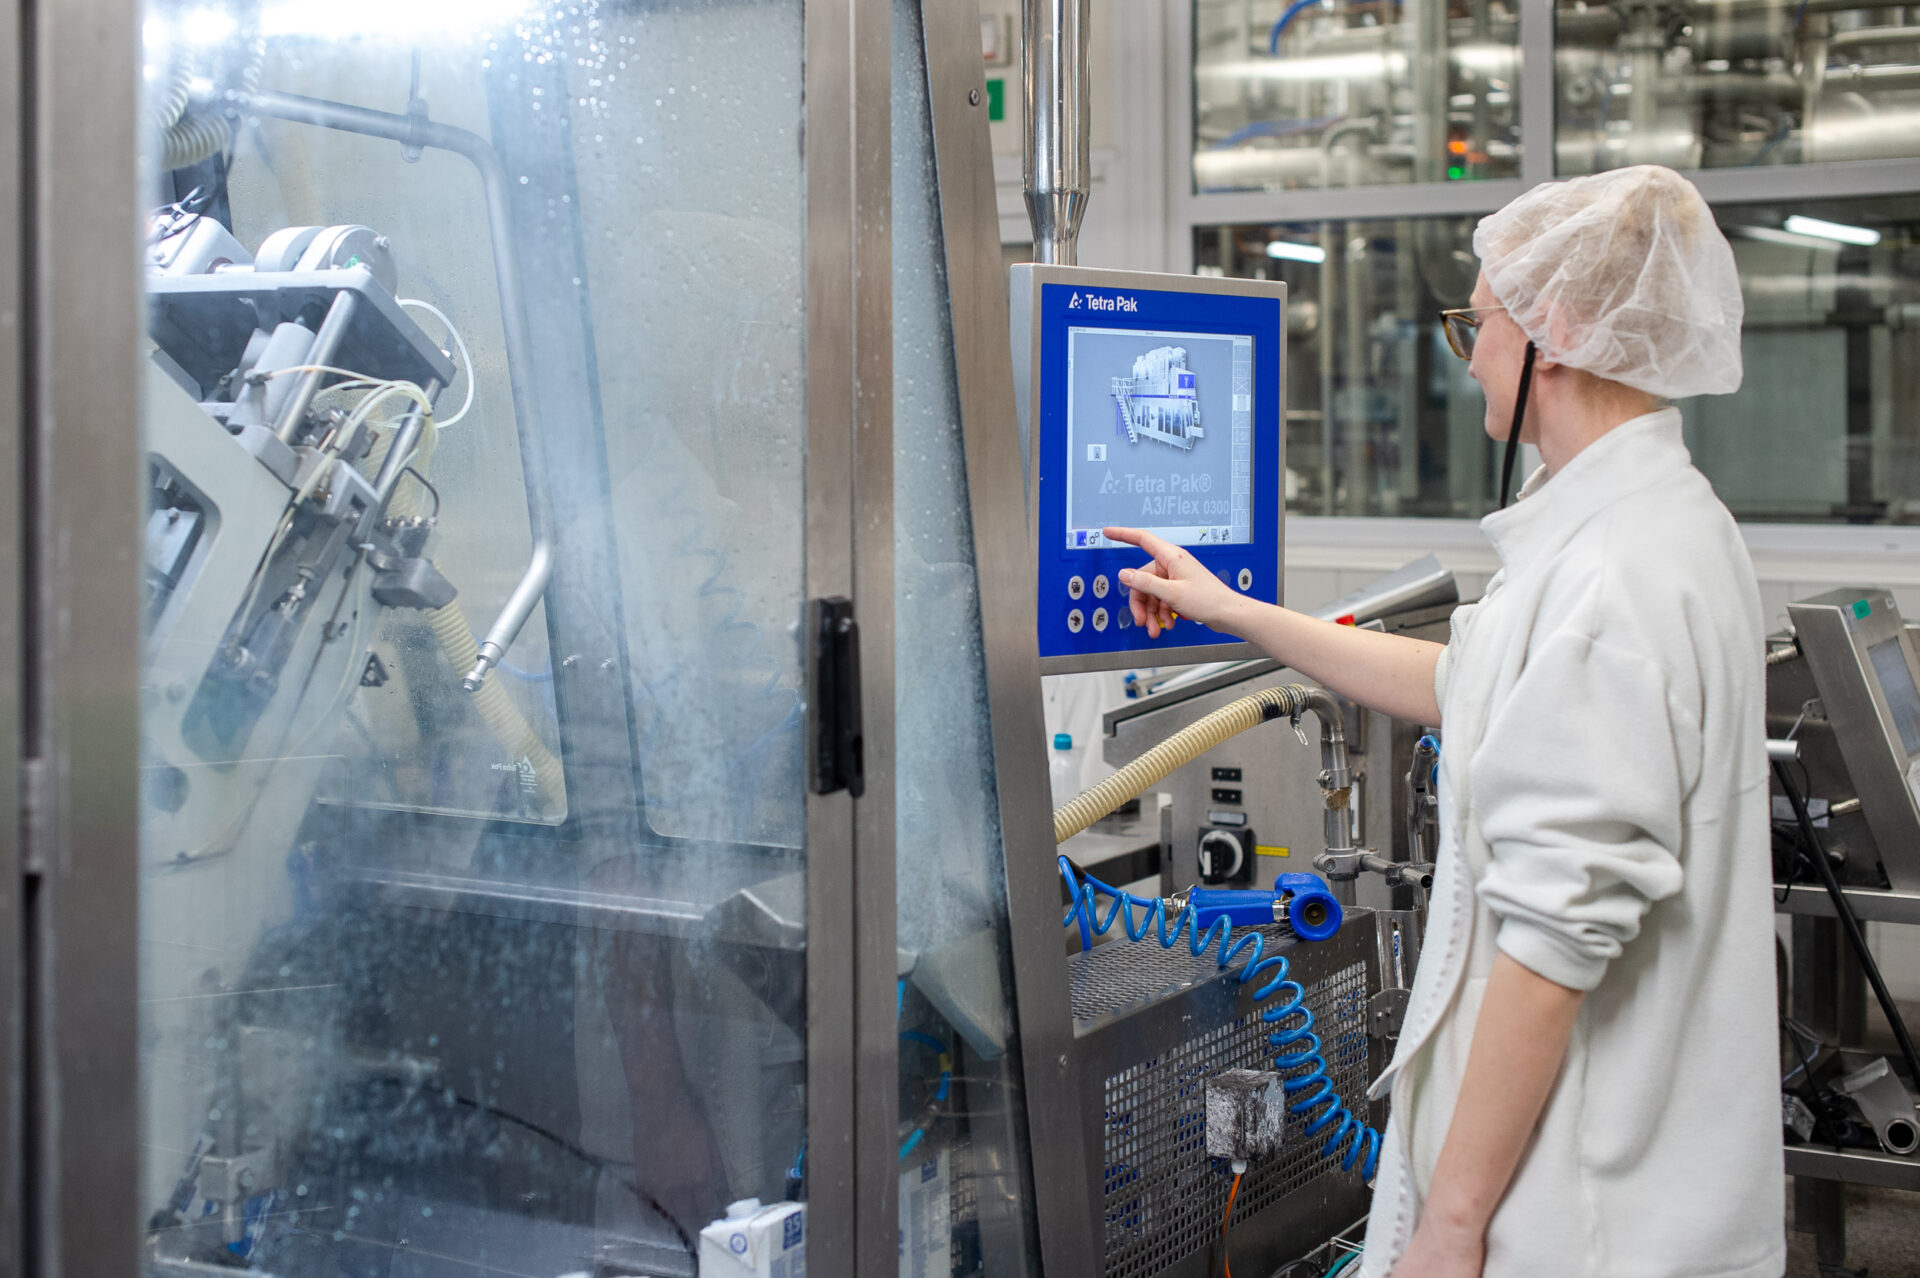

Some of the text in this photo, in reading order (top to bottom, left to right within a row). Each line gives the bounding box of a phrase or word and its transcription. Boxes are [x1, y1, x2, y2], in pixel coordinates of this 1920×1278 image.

[1085, 293, 1138, 313] Tetra Pak
[1124, 473, 1165, 494] Tetra
[1141, 495, 1230, 516] A3/Flex 0300
